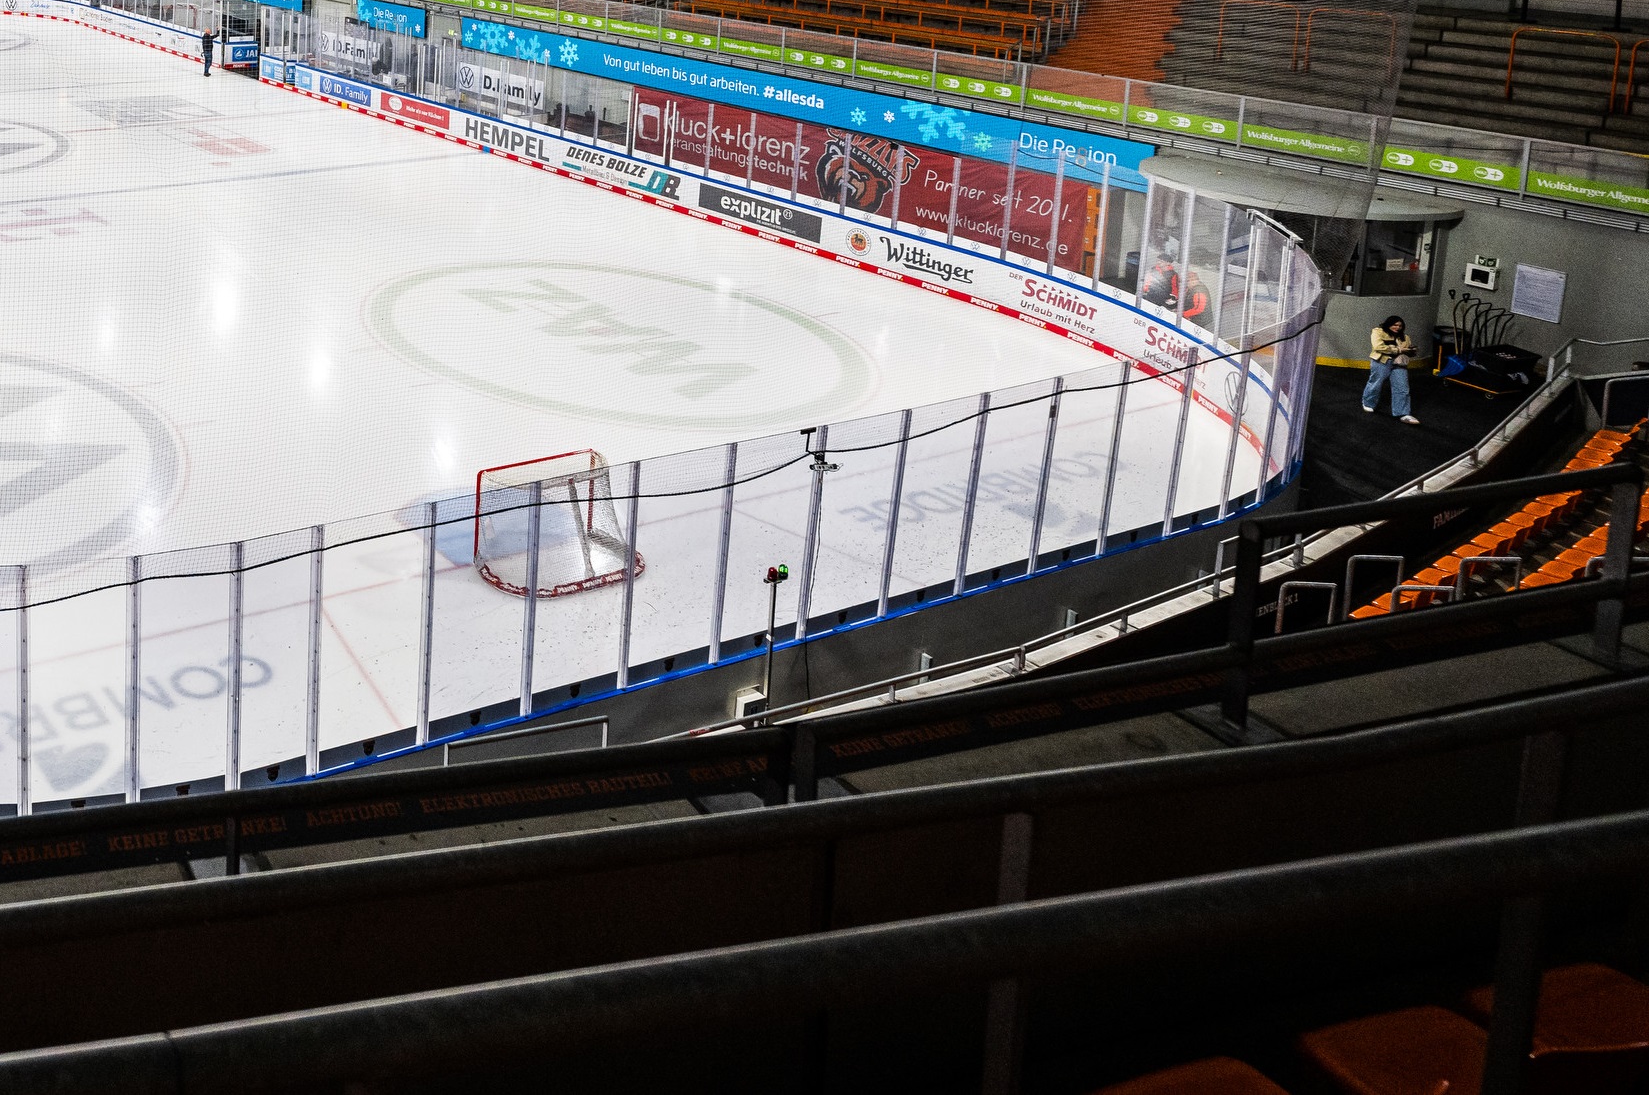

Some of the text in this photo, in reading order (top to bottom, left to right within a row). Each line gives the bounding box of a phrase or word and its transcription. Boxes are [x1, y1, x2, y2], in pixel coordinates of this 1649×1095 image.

[373, 6, 384, 18] Die
[333, 83, 344, 95] ID.
[345, 88, 369, 104] Family
[603, 53, 825, 109] Von gut leben bis gut arbeiten. #allesda
[1032, 93, 1108, 113] Wolfsburger Allgemeine
[465, 117, 550, 163] HEMPEL
[664, 107, 811, 165] kluck+lorenz
[1019, 132, 1049, 152] Die
[1246, 129, 1346, 154] Wolfsburger Allgemeine
[566, 146, 648, 179] DENES BOLZE
[838, 140, 888, 177] WLFSBURG
[924, 169, 1072, 222] Parner set 201.
[1536, 178, 1606, 197] Wolfsburger
[720, 195, 781, 225] explizit
[879, 236, 974, 284] Wittinger
[1008, 271, 1023, 281] DER
[1021, 278, 1098, 321] SCHMIDT
[1020, 299, 1096, 335] Urlaub mit Herz
[1133, 317, 1146, 328] DER
[306, 799, 402, 830] ACHTUNG!
[107, 815, 287, 853] KEINE GETRNKE!
[0, 837, 87, 868] ABLAGE!
